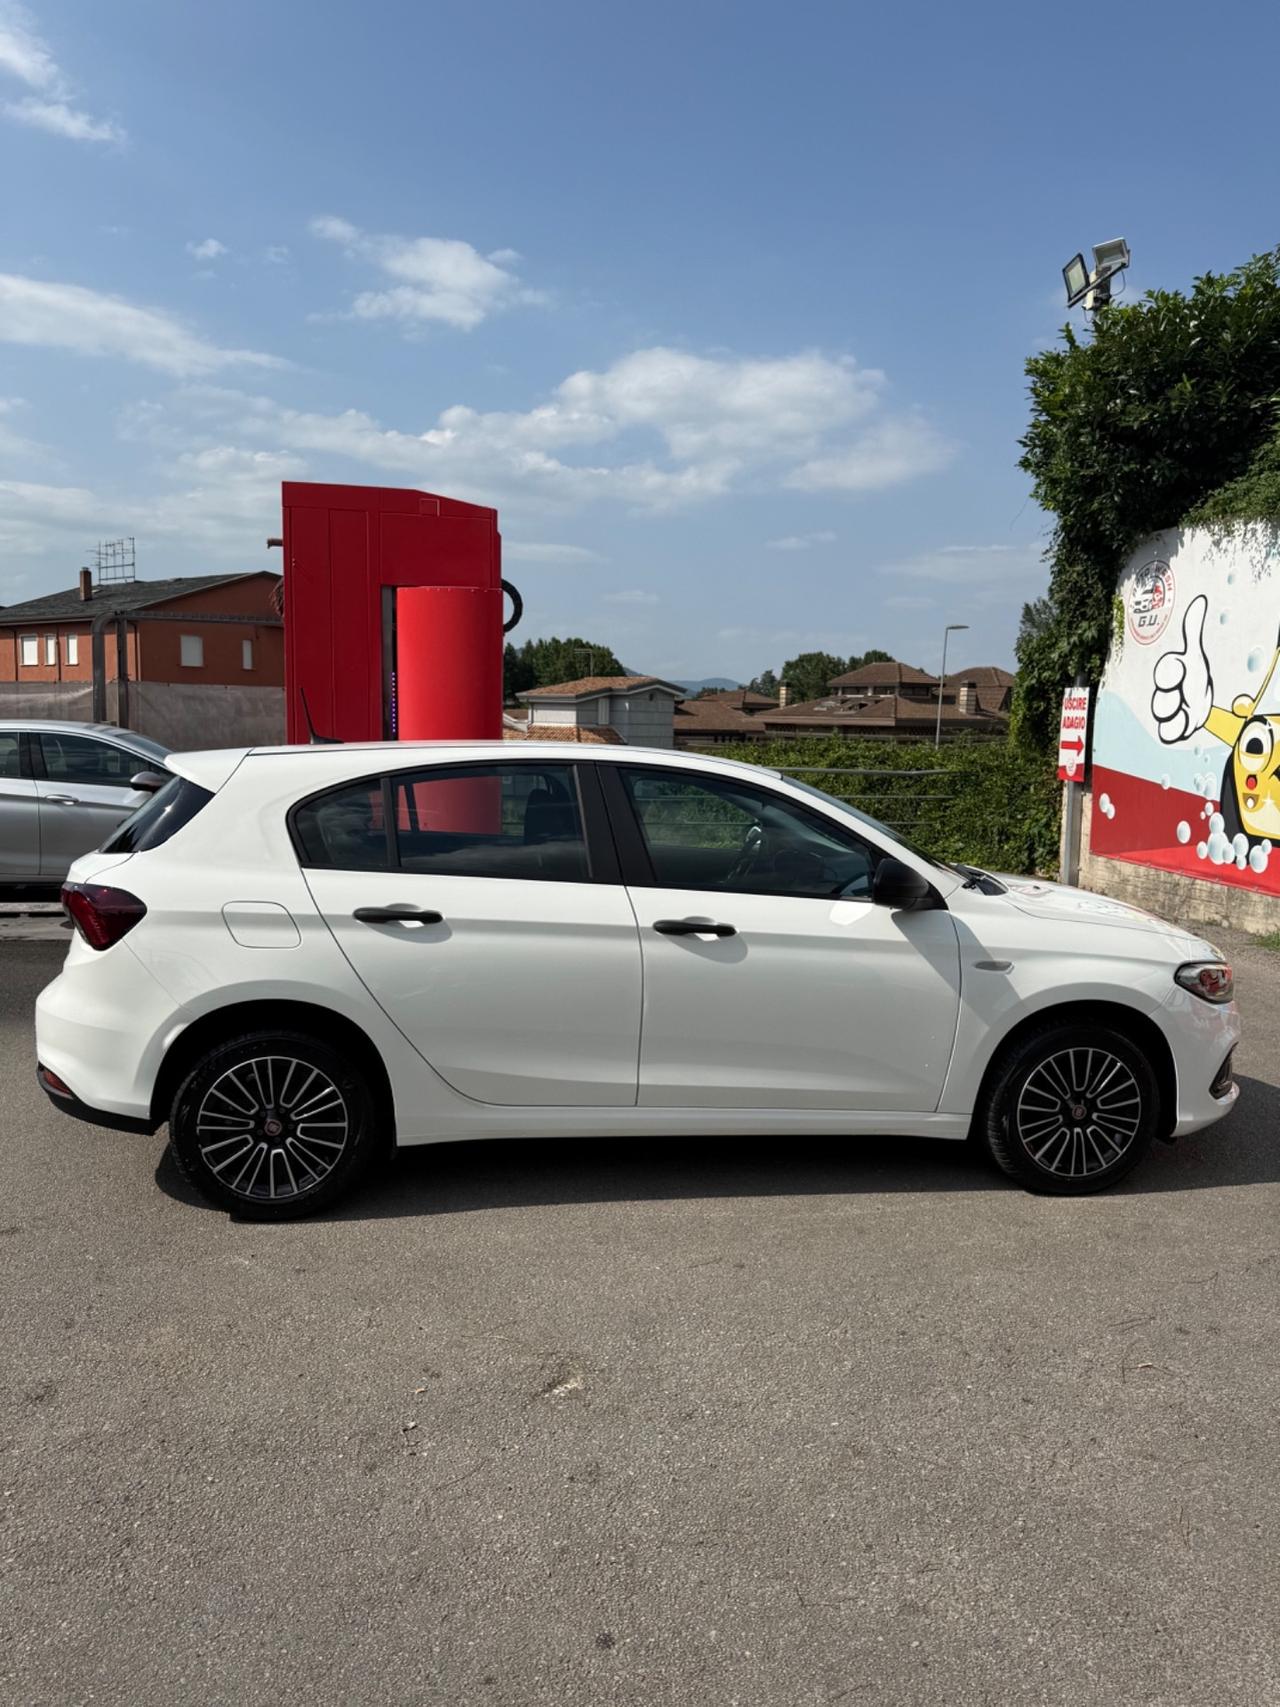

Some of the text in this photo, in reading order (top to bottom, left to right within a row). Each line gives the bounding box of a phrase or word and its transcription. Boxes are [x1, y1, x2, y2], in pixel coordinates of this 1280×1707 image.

[1138, 614, 1160, 628] G.U.
[1064, 696, 1087, 711] USCIRE
[1062, 715, 1086, 730] ADAGIO
